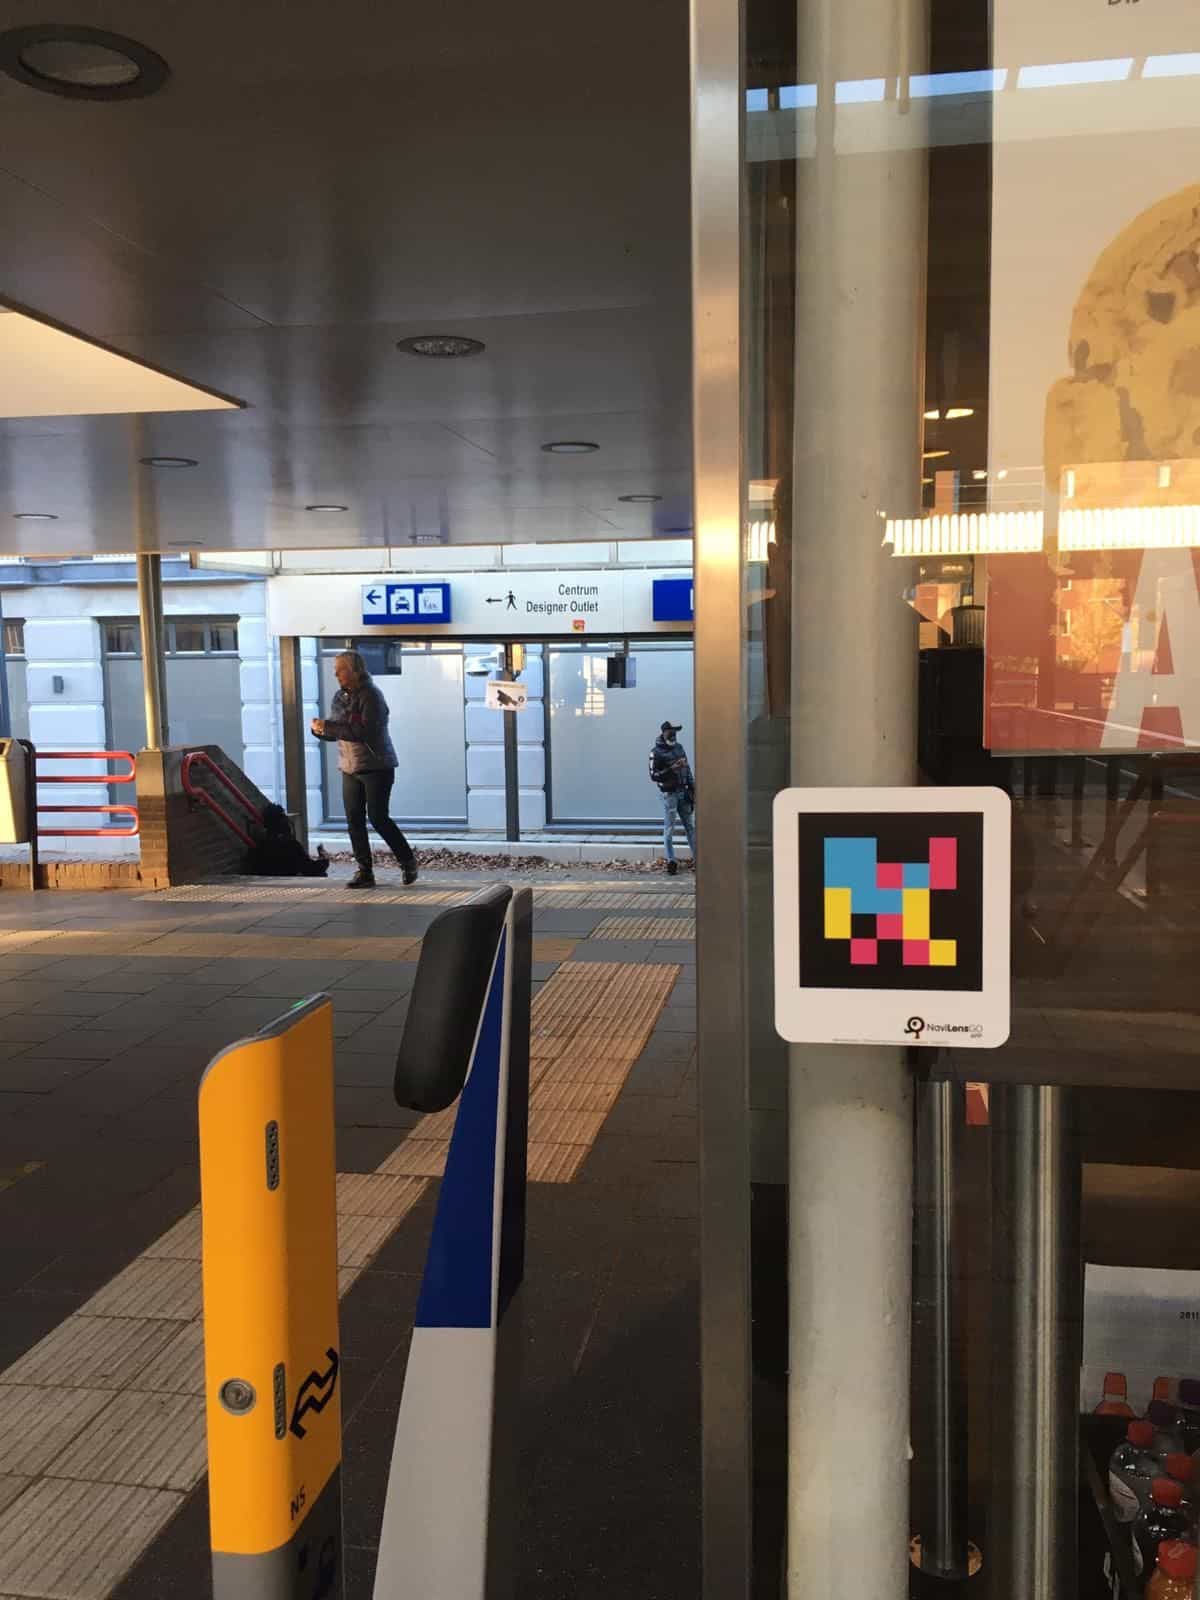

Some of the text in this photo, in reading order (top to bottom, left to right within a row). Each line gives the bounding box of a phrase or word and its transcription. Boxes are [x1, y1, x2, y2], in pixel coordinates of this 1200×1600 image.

[558, 584, 598, 596] Centrum
[526, 601, 598, 615] Designer Outlet
[291, 1484, 305, 1521] NS
